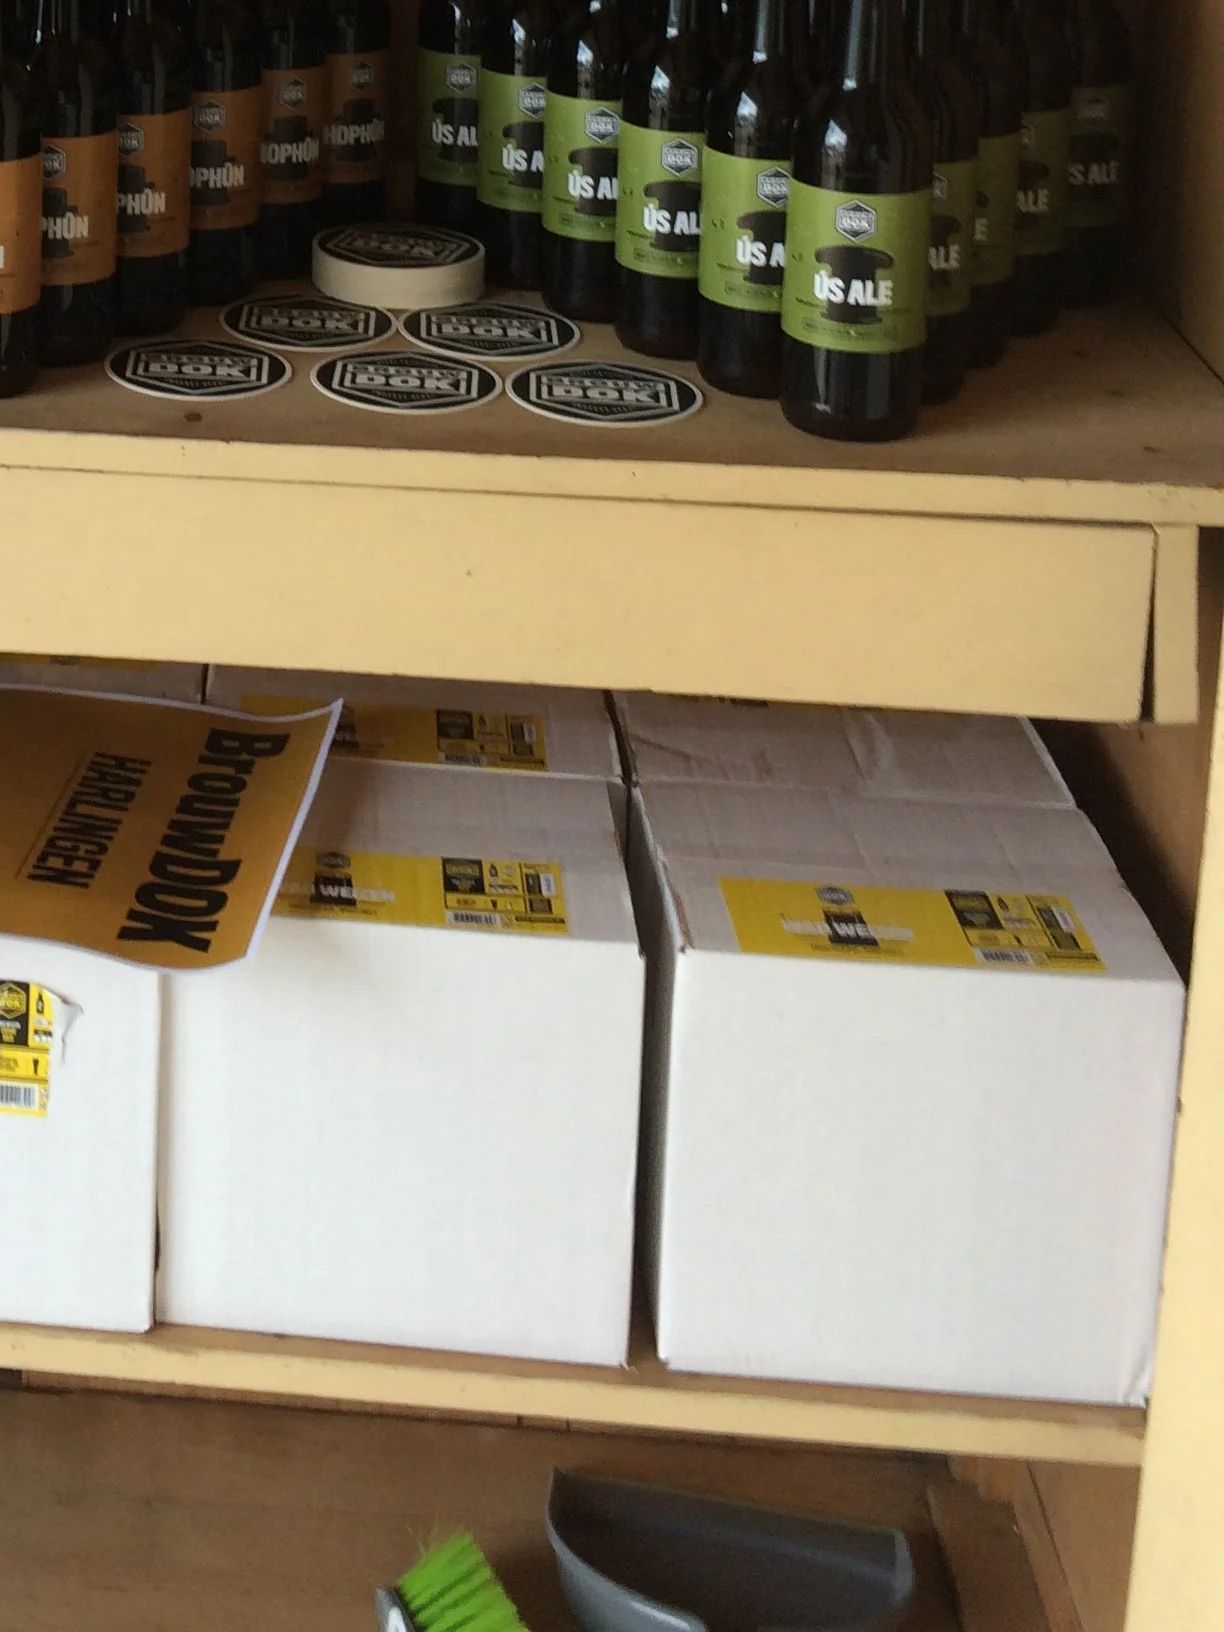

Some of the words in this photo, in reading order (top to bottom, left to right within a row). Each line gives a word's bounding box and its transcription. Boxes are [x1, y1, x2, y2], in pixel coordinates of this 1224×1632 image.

[456, 125, 479, 147] AL
[673, 211, 702, 236] AL
[846, 279, 894, 308] ALE
[355, 372, 461, 393] DOK
[552, 383, 660, 404] DOK
[27, 751, 152, 889] HARLINGEN
